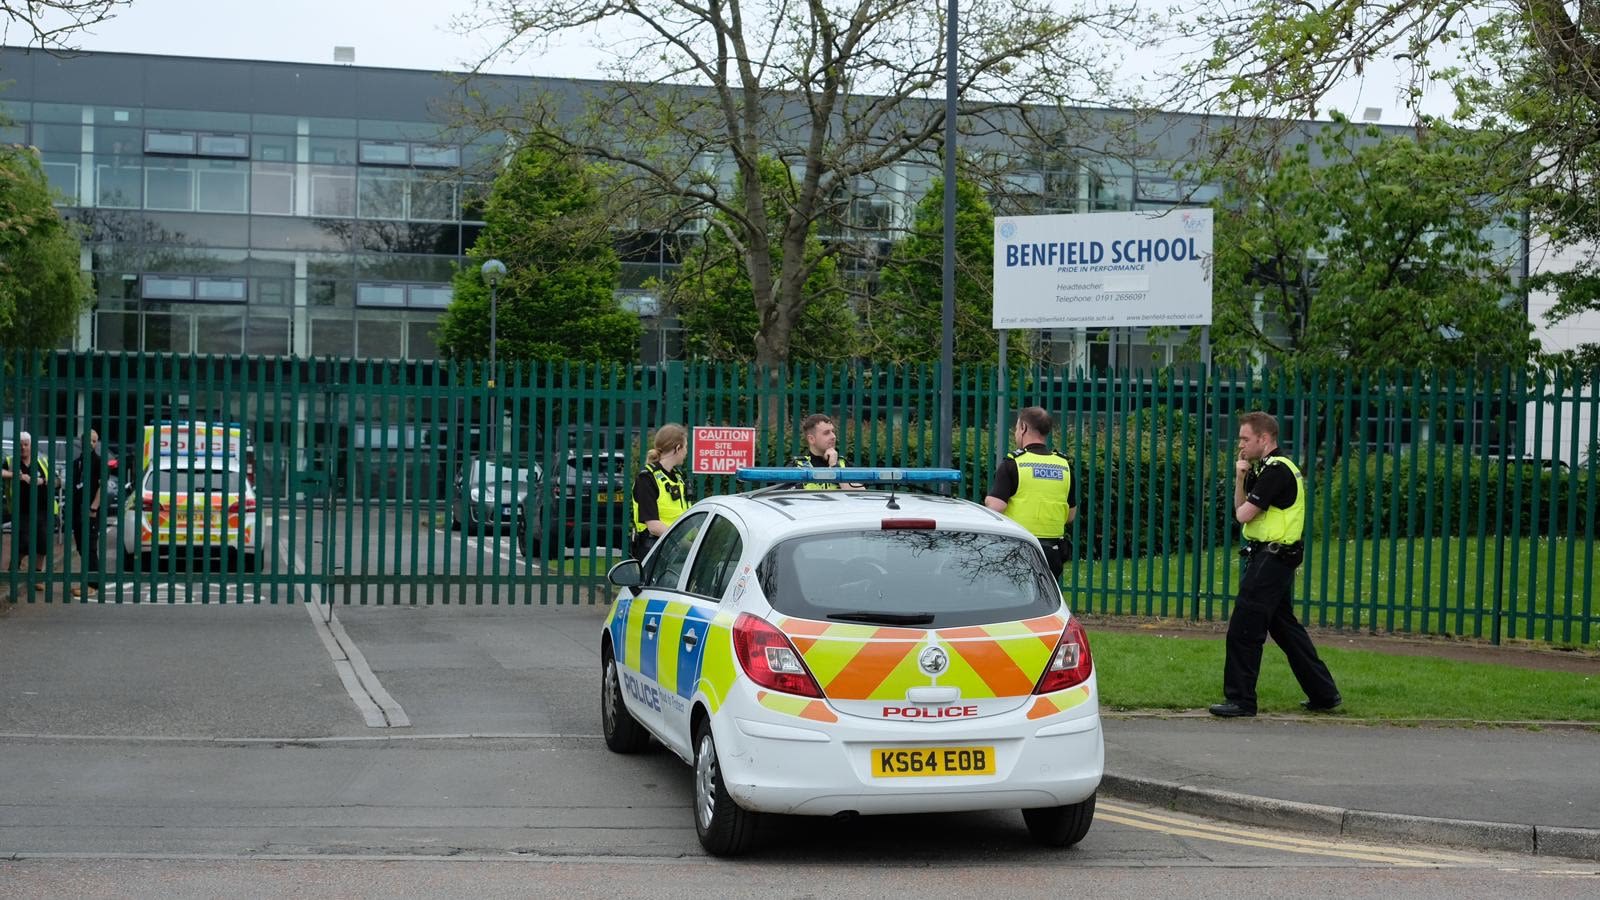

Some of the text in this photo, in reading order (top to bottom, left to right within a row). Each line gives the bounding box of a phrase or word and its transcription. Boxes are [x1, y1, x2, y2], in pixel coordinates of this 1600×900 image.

[1007, 237, 1197, 267] BENFIELD SCHOOL
[1090, 264, 1145, 272] PERFORMANCE
[1057, 282, 1104, 291] Headteacher:
[1055, 293, 1146, 303] Telephone: 0191 2656091
[698, 429, 750, 440] CAUTION
[714, 442, 732, 450] SITE
[699, 449, 748, 457] SPEED LIMIT
[700, 458, 747, 471] 5 MPH
[1034, 469, 1063, 479] POLICE
[624, 672, 661, 712] POLICE
[882, 705, 978, 718] POLICE
[881, 750, 986, 773] KS64 EOB
